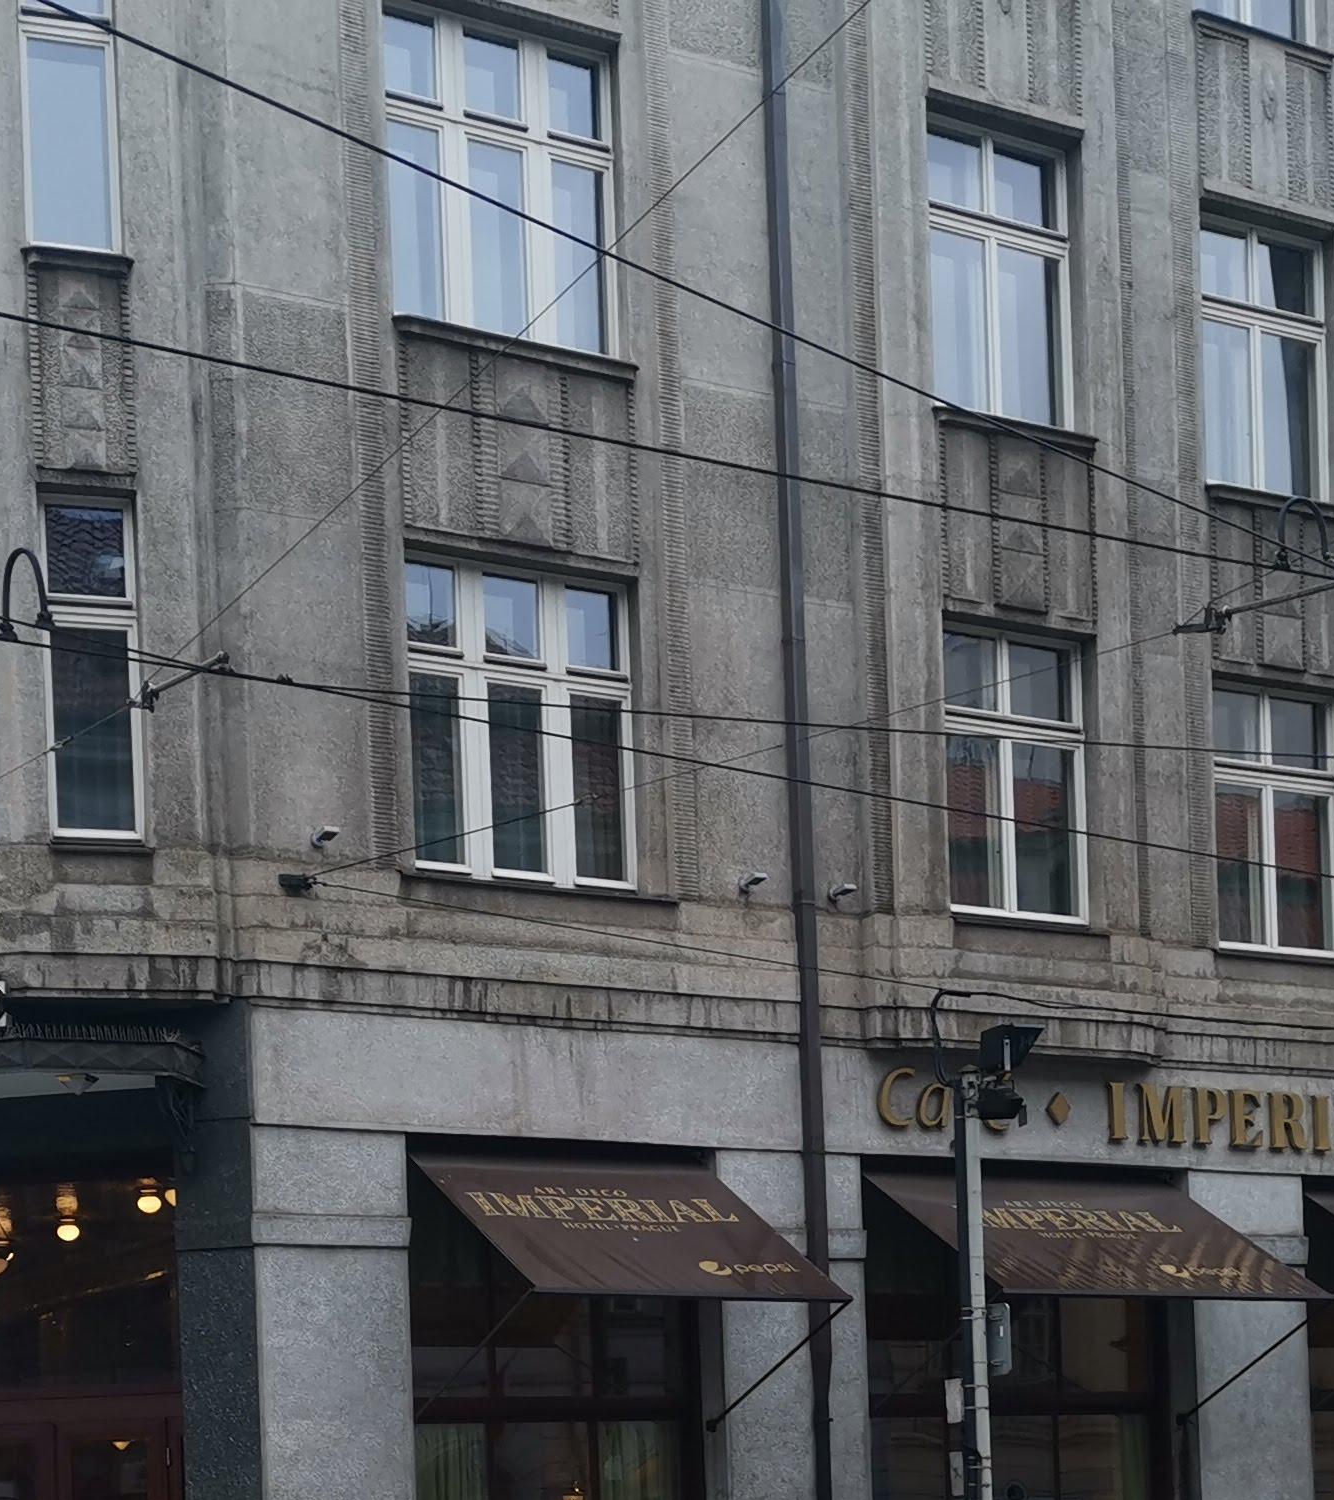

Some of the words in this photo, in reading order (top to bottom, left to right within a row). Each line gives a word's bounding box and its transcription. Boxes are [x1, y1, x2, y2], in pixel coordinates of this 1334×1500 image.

[533, 1185, 566, 1196] ART
[576, 1187, 628, 1198] DECO
[464, 1190, 741, 1224] IMPERIAL
[982, 1207, 1184, 1233] MPERIAL
